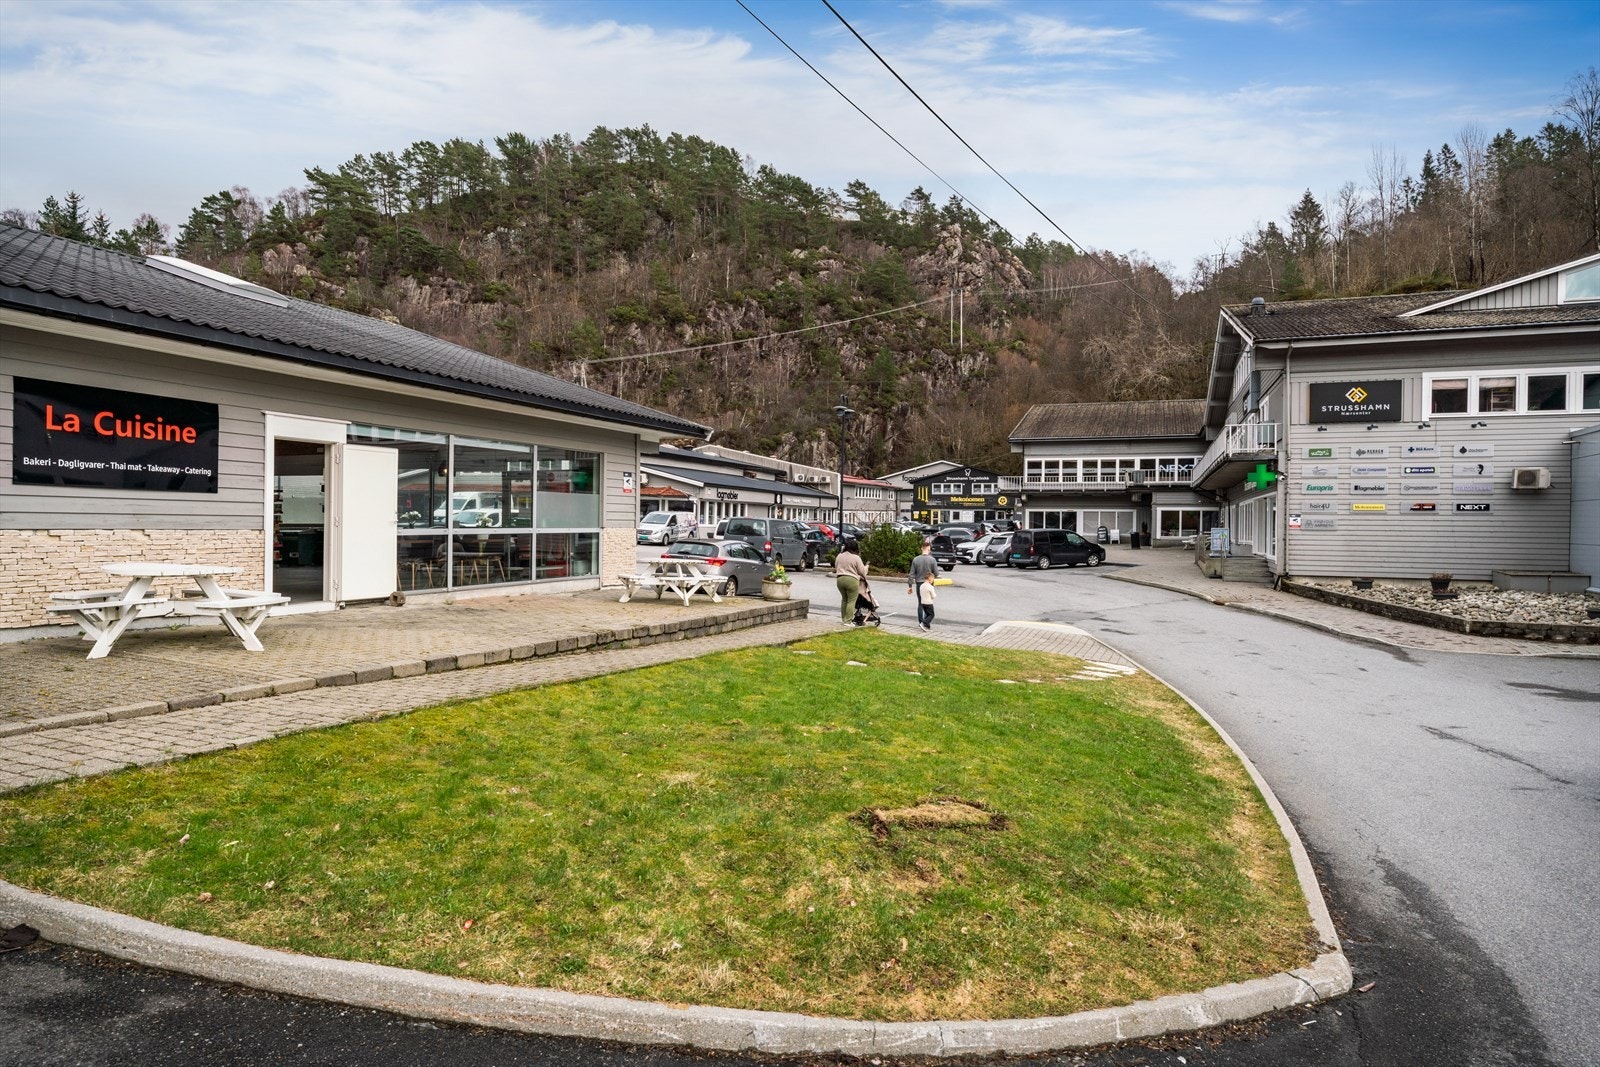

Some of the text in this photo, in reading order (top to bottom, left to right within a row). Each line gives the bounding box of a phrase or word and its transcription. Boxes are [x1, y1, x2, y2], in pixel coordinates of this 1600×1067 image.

[1321, 404, 1390, 412] STRUSSHAMN
[46, 404, 197, 444] La Cuisine
[23, 457, 52, 466] Bakeri
[58, 459, 105, 470] Dagligvarer
[110, 462, 126, 470] Thai
[127, 463, 142, 471] mat
[147, 464, 180, 474] Takeaway
[185, 467, 212, 477] Catering
[1306, 484, 1334, 492] Europris
[1309, 503, 1330, 511] hair4U
